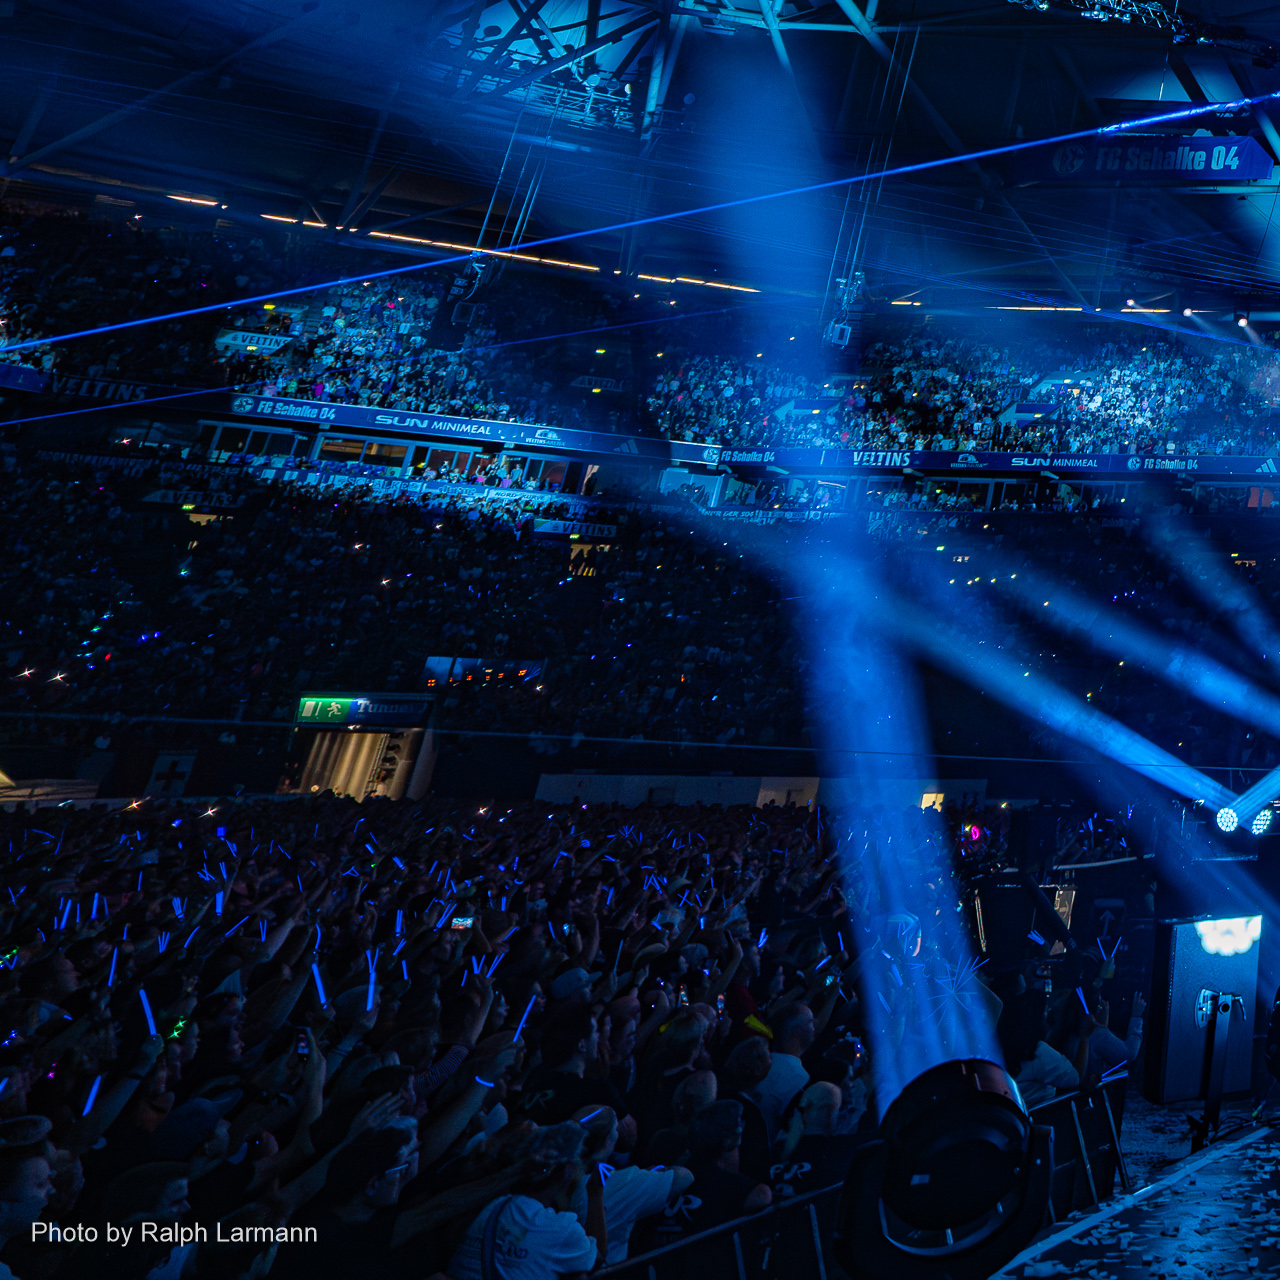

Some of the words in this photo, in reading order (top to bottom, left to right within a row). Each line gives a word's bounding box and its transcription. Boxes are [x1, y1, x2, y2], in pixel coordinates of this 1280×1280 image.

[1124, 144, 1206, 171] Schalke
[1211, 145, 1240, 170] 04
[240, 333, 290, 348] VELTINS
[51, 375, 148, 401] VELTINS
[256, 400, 273, 413] FC
[273, 402, 318, 418] Schalke
[318, 407, 337, 420] 04
[374, 414, 429, 429] SUN
[431, 420, 492, 436] MINIMEAL
[720, 450, 731, 462] FC
[731, 450, 762, 462] Schalke
[763, 451, 776, 463] 04
[853, 451, 911, 467] VELTINS
[1010, 457, 1051, 467] SUN
[1052, 457, 1098, 468] MINIMEAL
[1143, 458, 1155, 469] FC
[1155, 458, 1186, 470] Schalke
[1186, 458, 1198, 471] 04
[562, 521, 614, 538] VELTINS
[663, 1194, 703, 1224] UR
